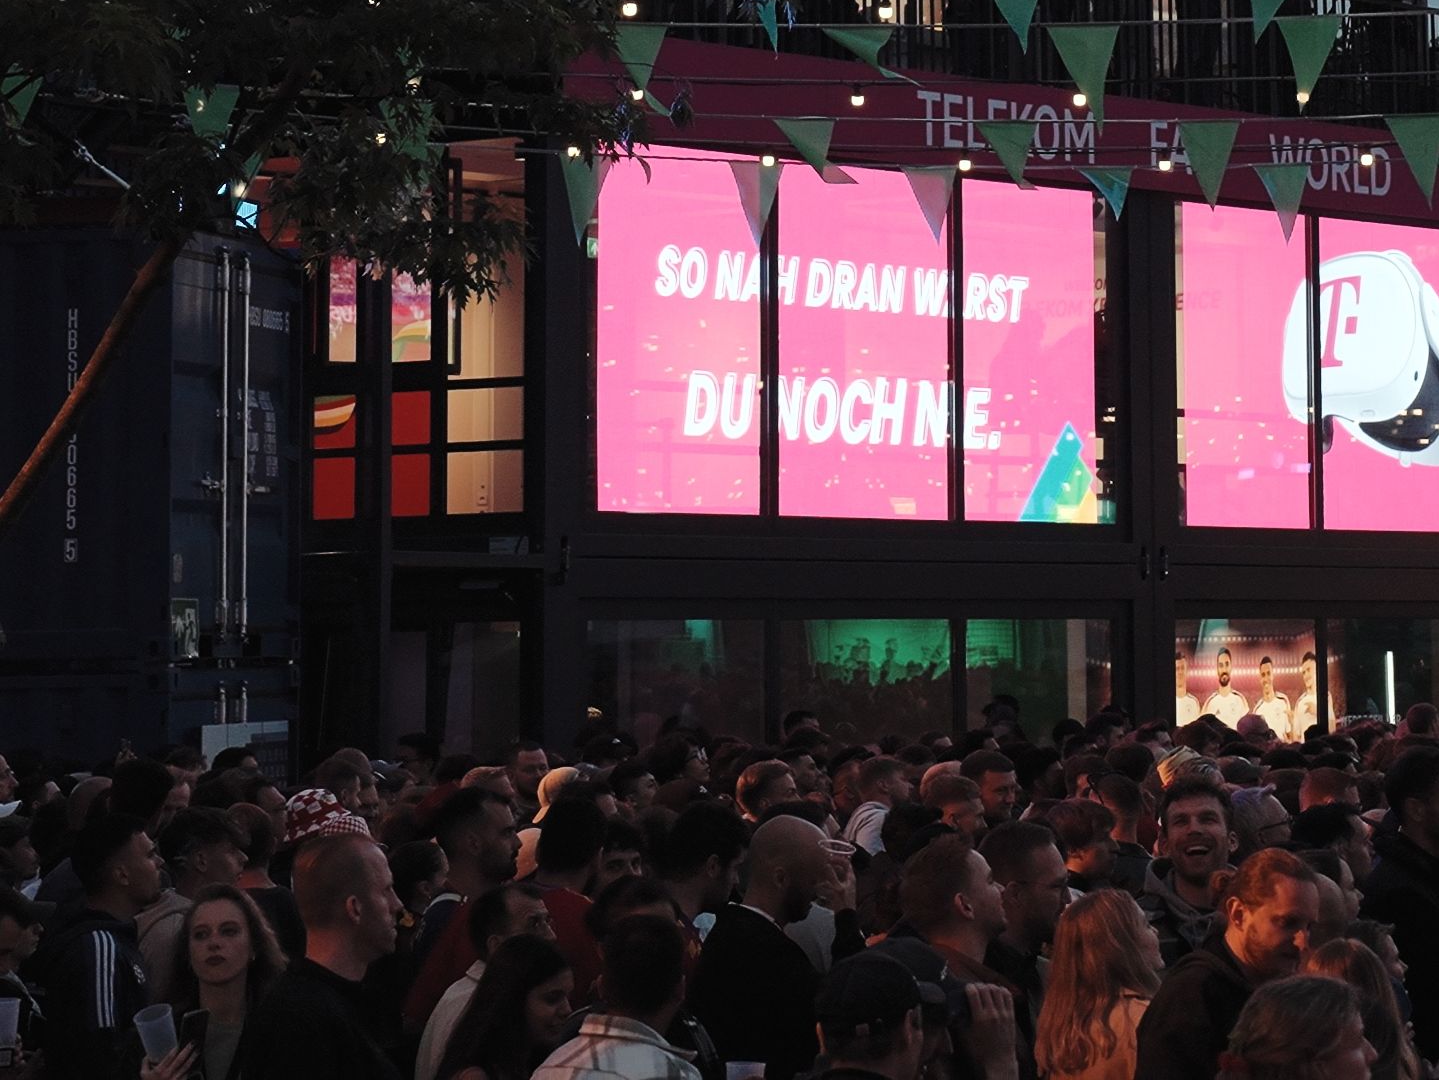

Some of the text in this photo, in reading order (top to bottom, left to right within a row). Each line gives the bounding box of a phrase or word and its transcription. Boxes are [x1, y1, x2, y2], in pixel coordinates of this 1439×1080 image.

[1269, 133, 1392, 196] WORLD
[655, 244, 708, 299] SO
[805, 258, 906, 314] DRAN
[914, 267, 1029, 324] WRST
[64, 308, 78, 563] HBSU 0665 5
[683, 370, 1001, 450] DU NOCH NE.
